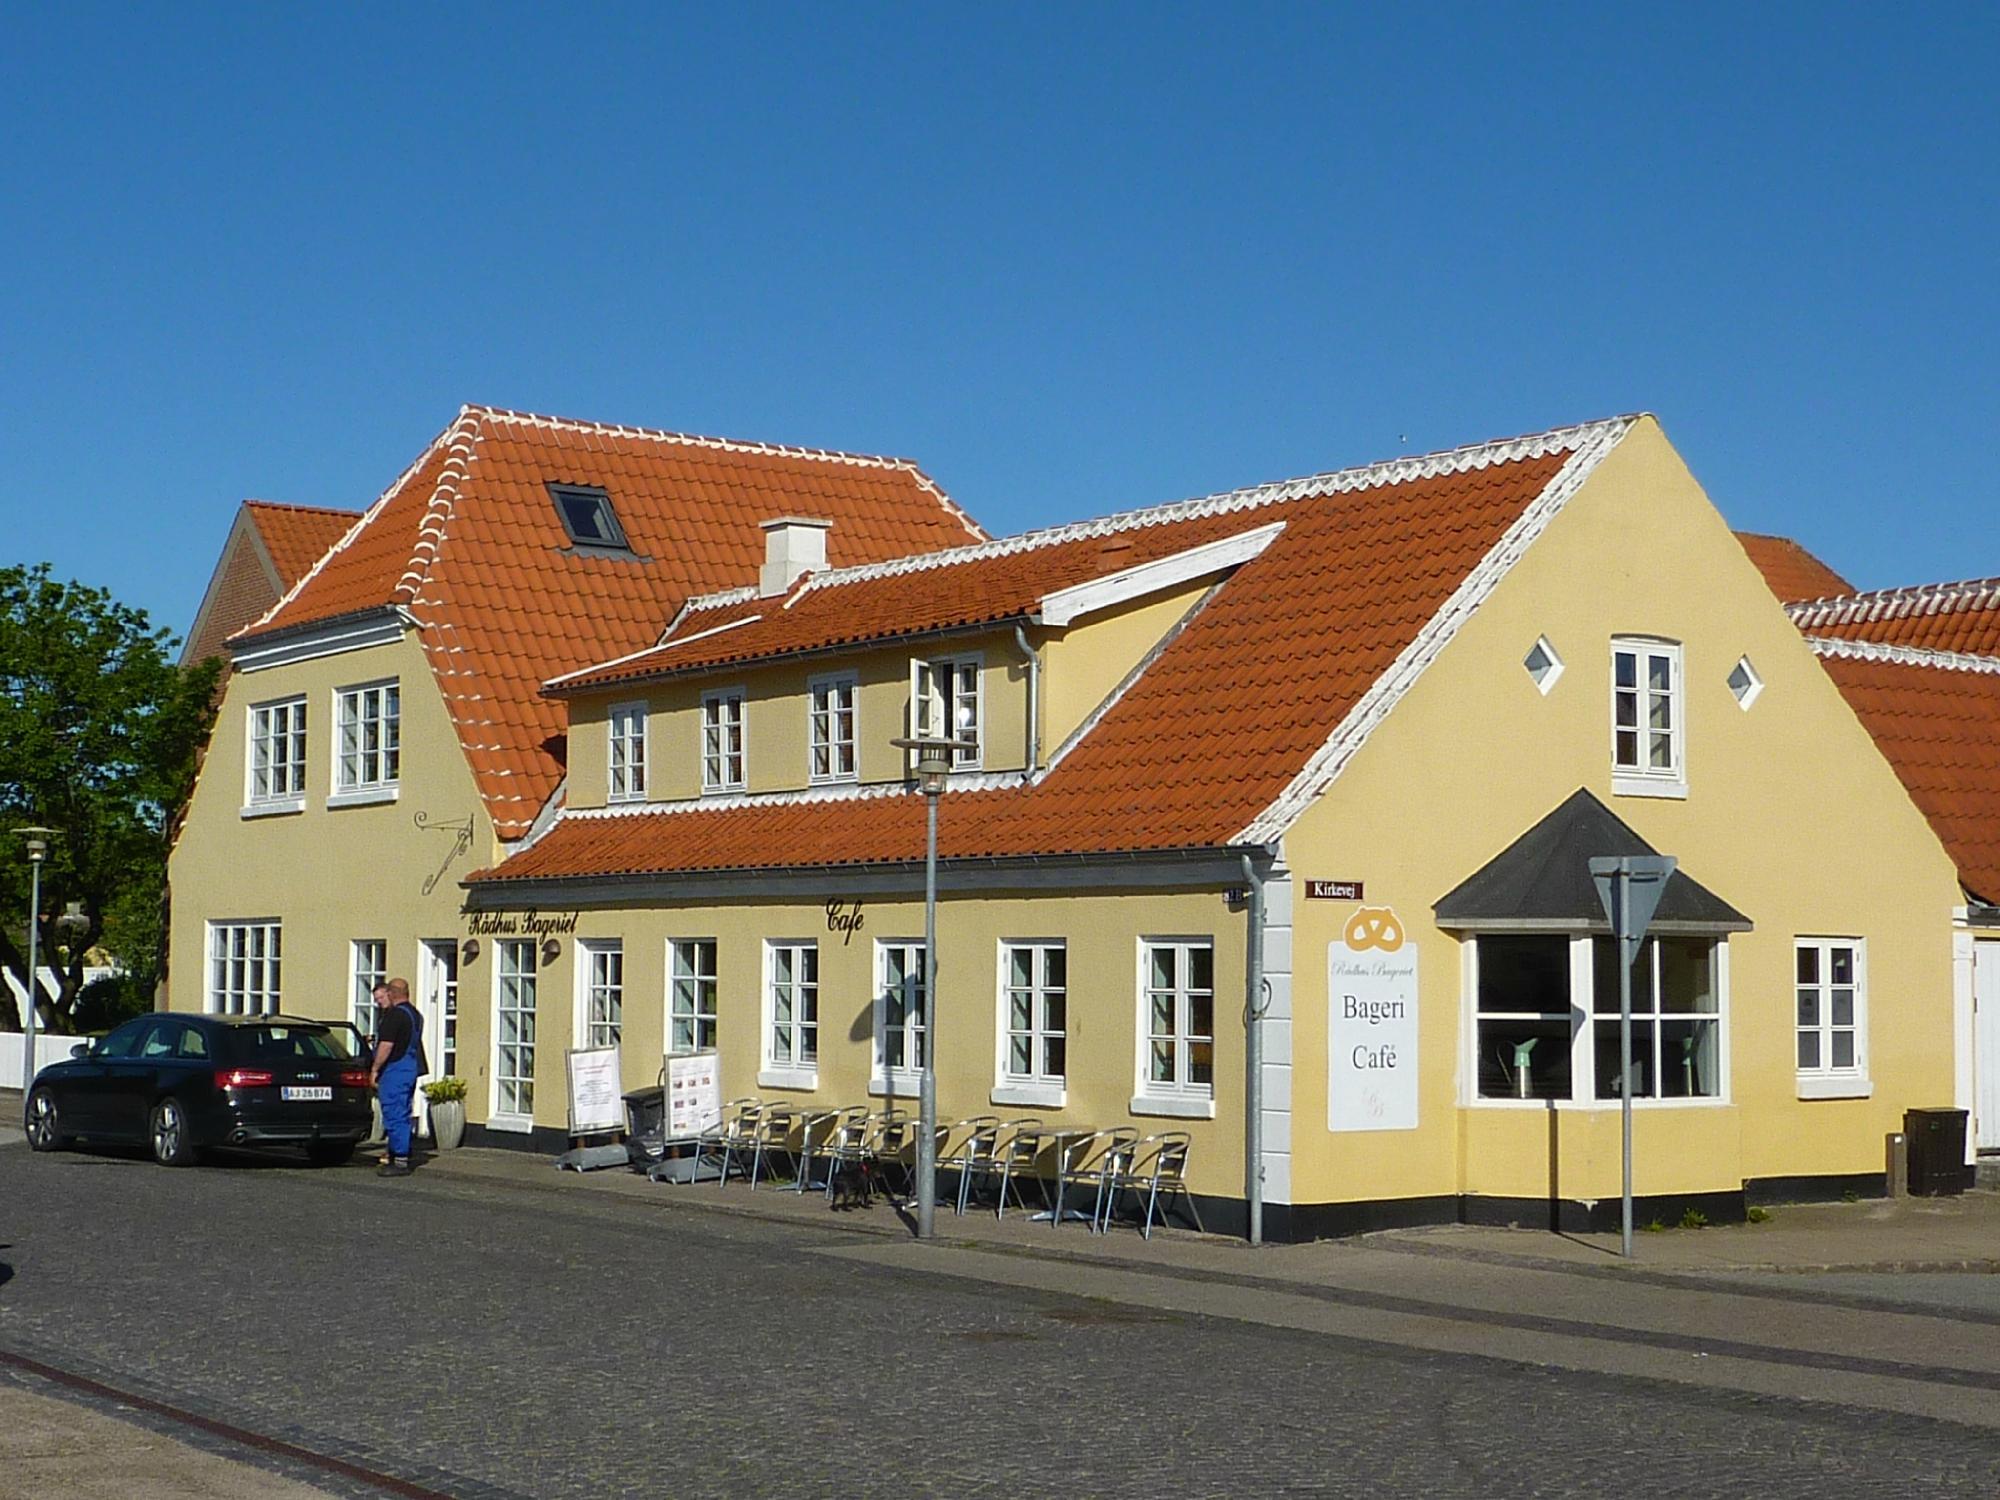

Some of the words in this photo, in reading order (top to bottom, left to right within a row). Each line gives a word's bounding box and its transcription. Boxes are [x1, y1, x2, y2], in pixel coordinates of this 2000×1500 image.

[1314, 881, 1355, 899] Kirkevej
[1343, 994, 1404, 1025] Bageri
[1352, 1044, 1397, 1069] Café
